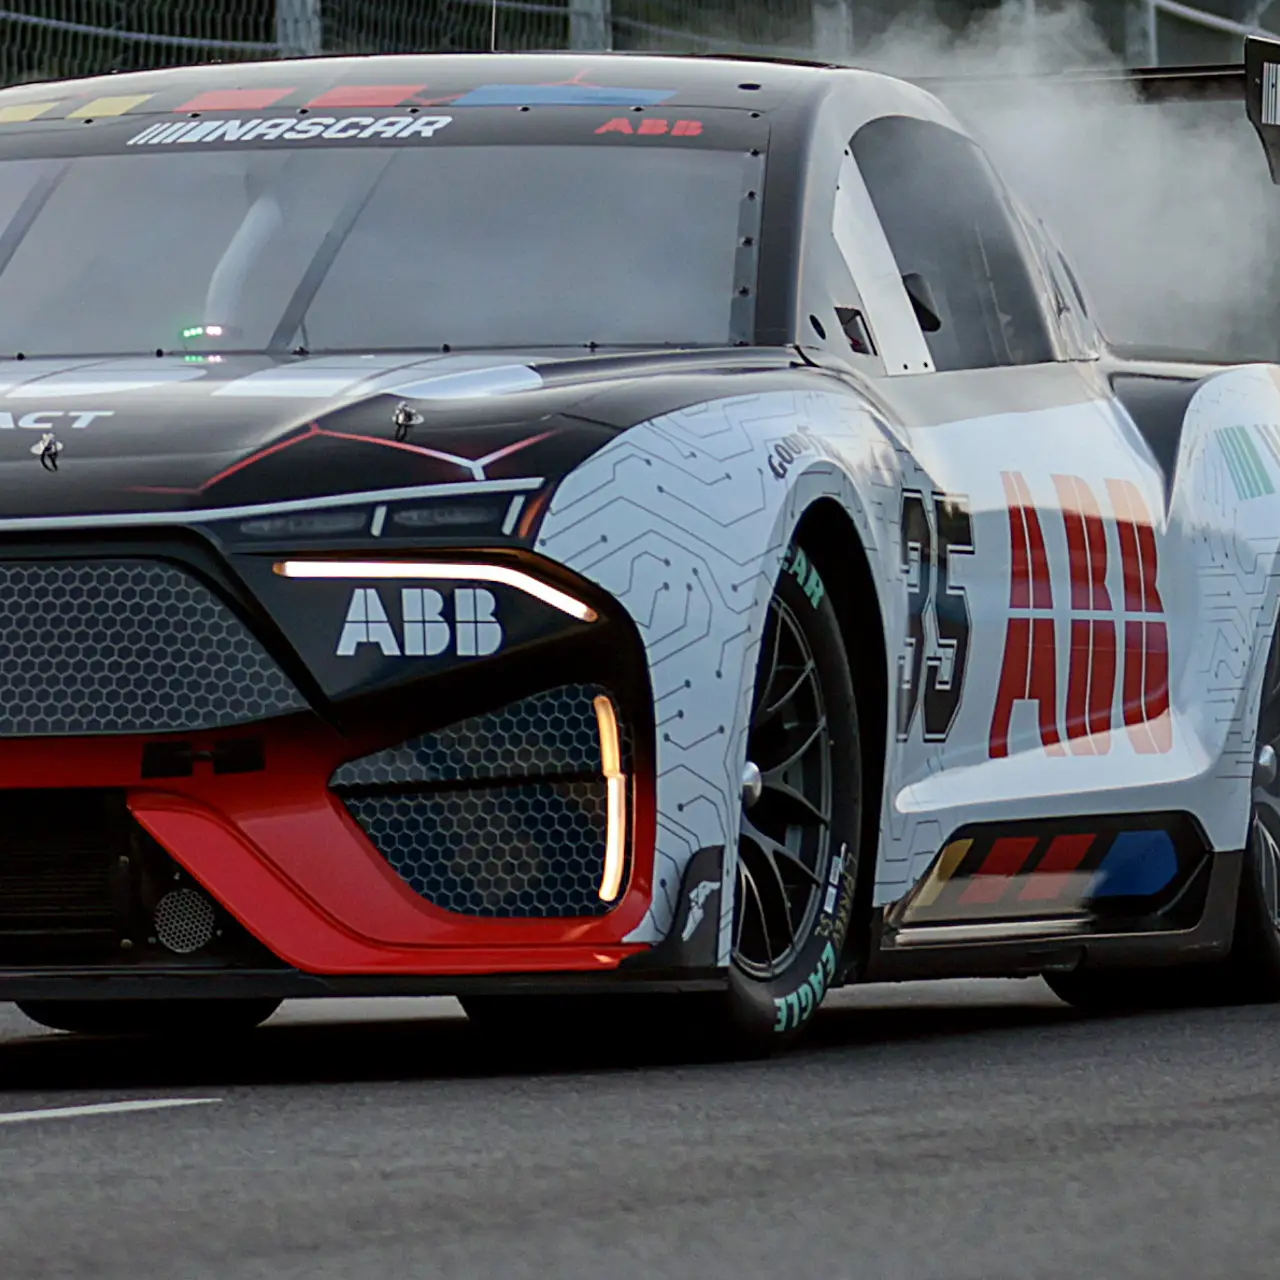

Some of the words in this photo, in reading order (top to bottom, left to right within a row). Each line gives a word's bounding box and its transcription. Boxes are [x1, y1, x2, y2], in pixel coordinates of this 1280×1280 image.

[187, 116, 452, 143] NASCAR
[594, 117, 704, 136] ABB
[336, 588, 502, 657] ABB
[896, 488, 976, 743] 35
[989, 471, 1173, 759] ABB
[773, 940, 837, 1032] EAGLE
